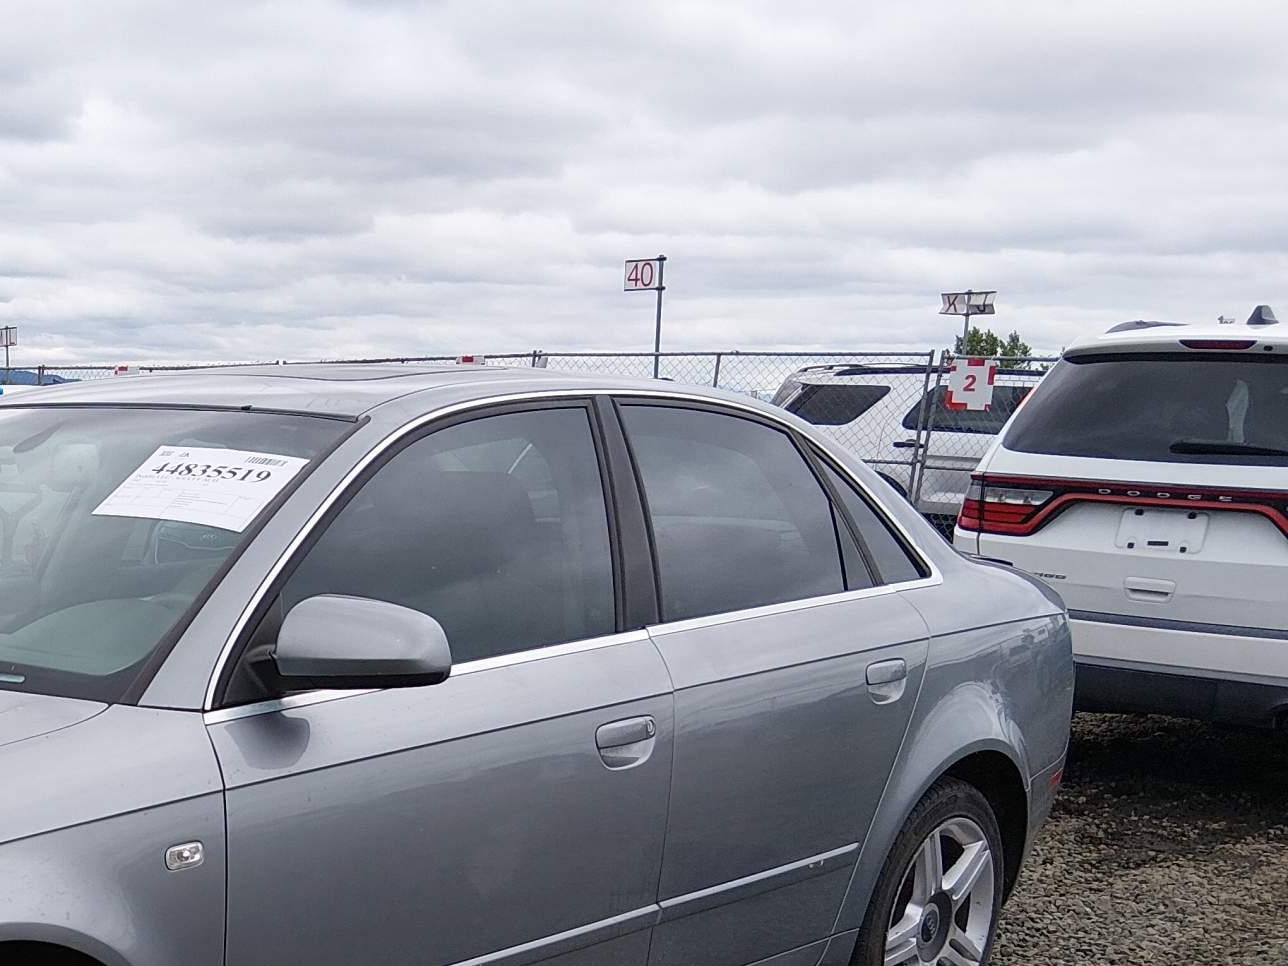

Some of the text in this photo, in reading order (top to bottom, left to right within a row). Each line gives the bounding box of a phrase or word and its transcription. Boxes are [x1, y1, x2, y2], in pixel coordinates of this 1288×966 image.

[627, 262, 654, 287] 40
[944, 295, 958, 313] K
[976, 294, 988, 313] J
[9, 329, 16, 345] L
[962, 374, 977, 392] 2
[151, 462, 272, 483] 44835519
[1098, 488, 1233, 502] DODGE
